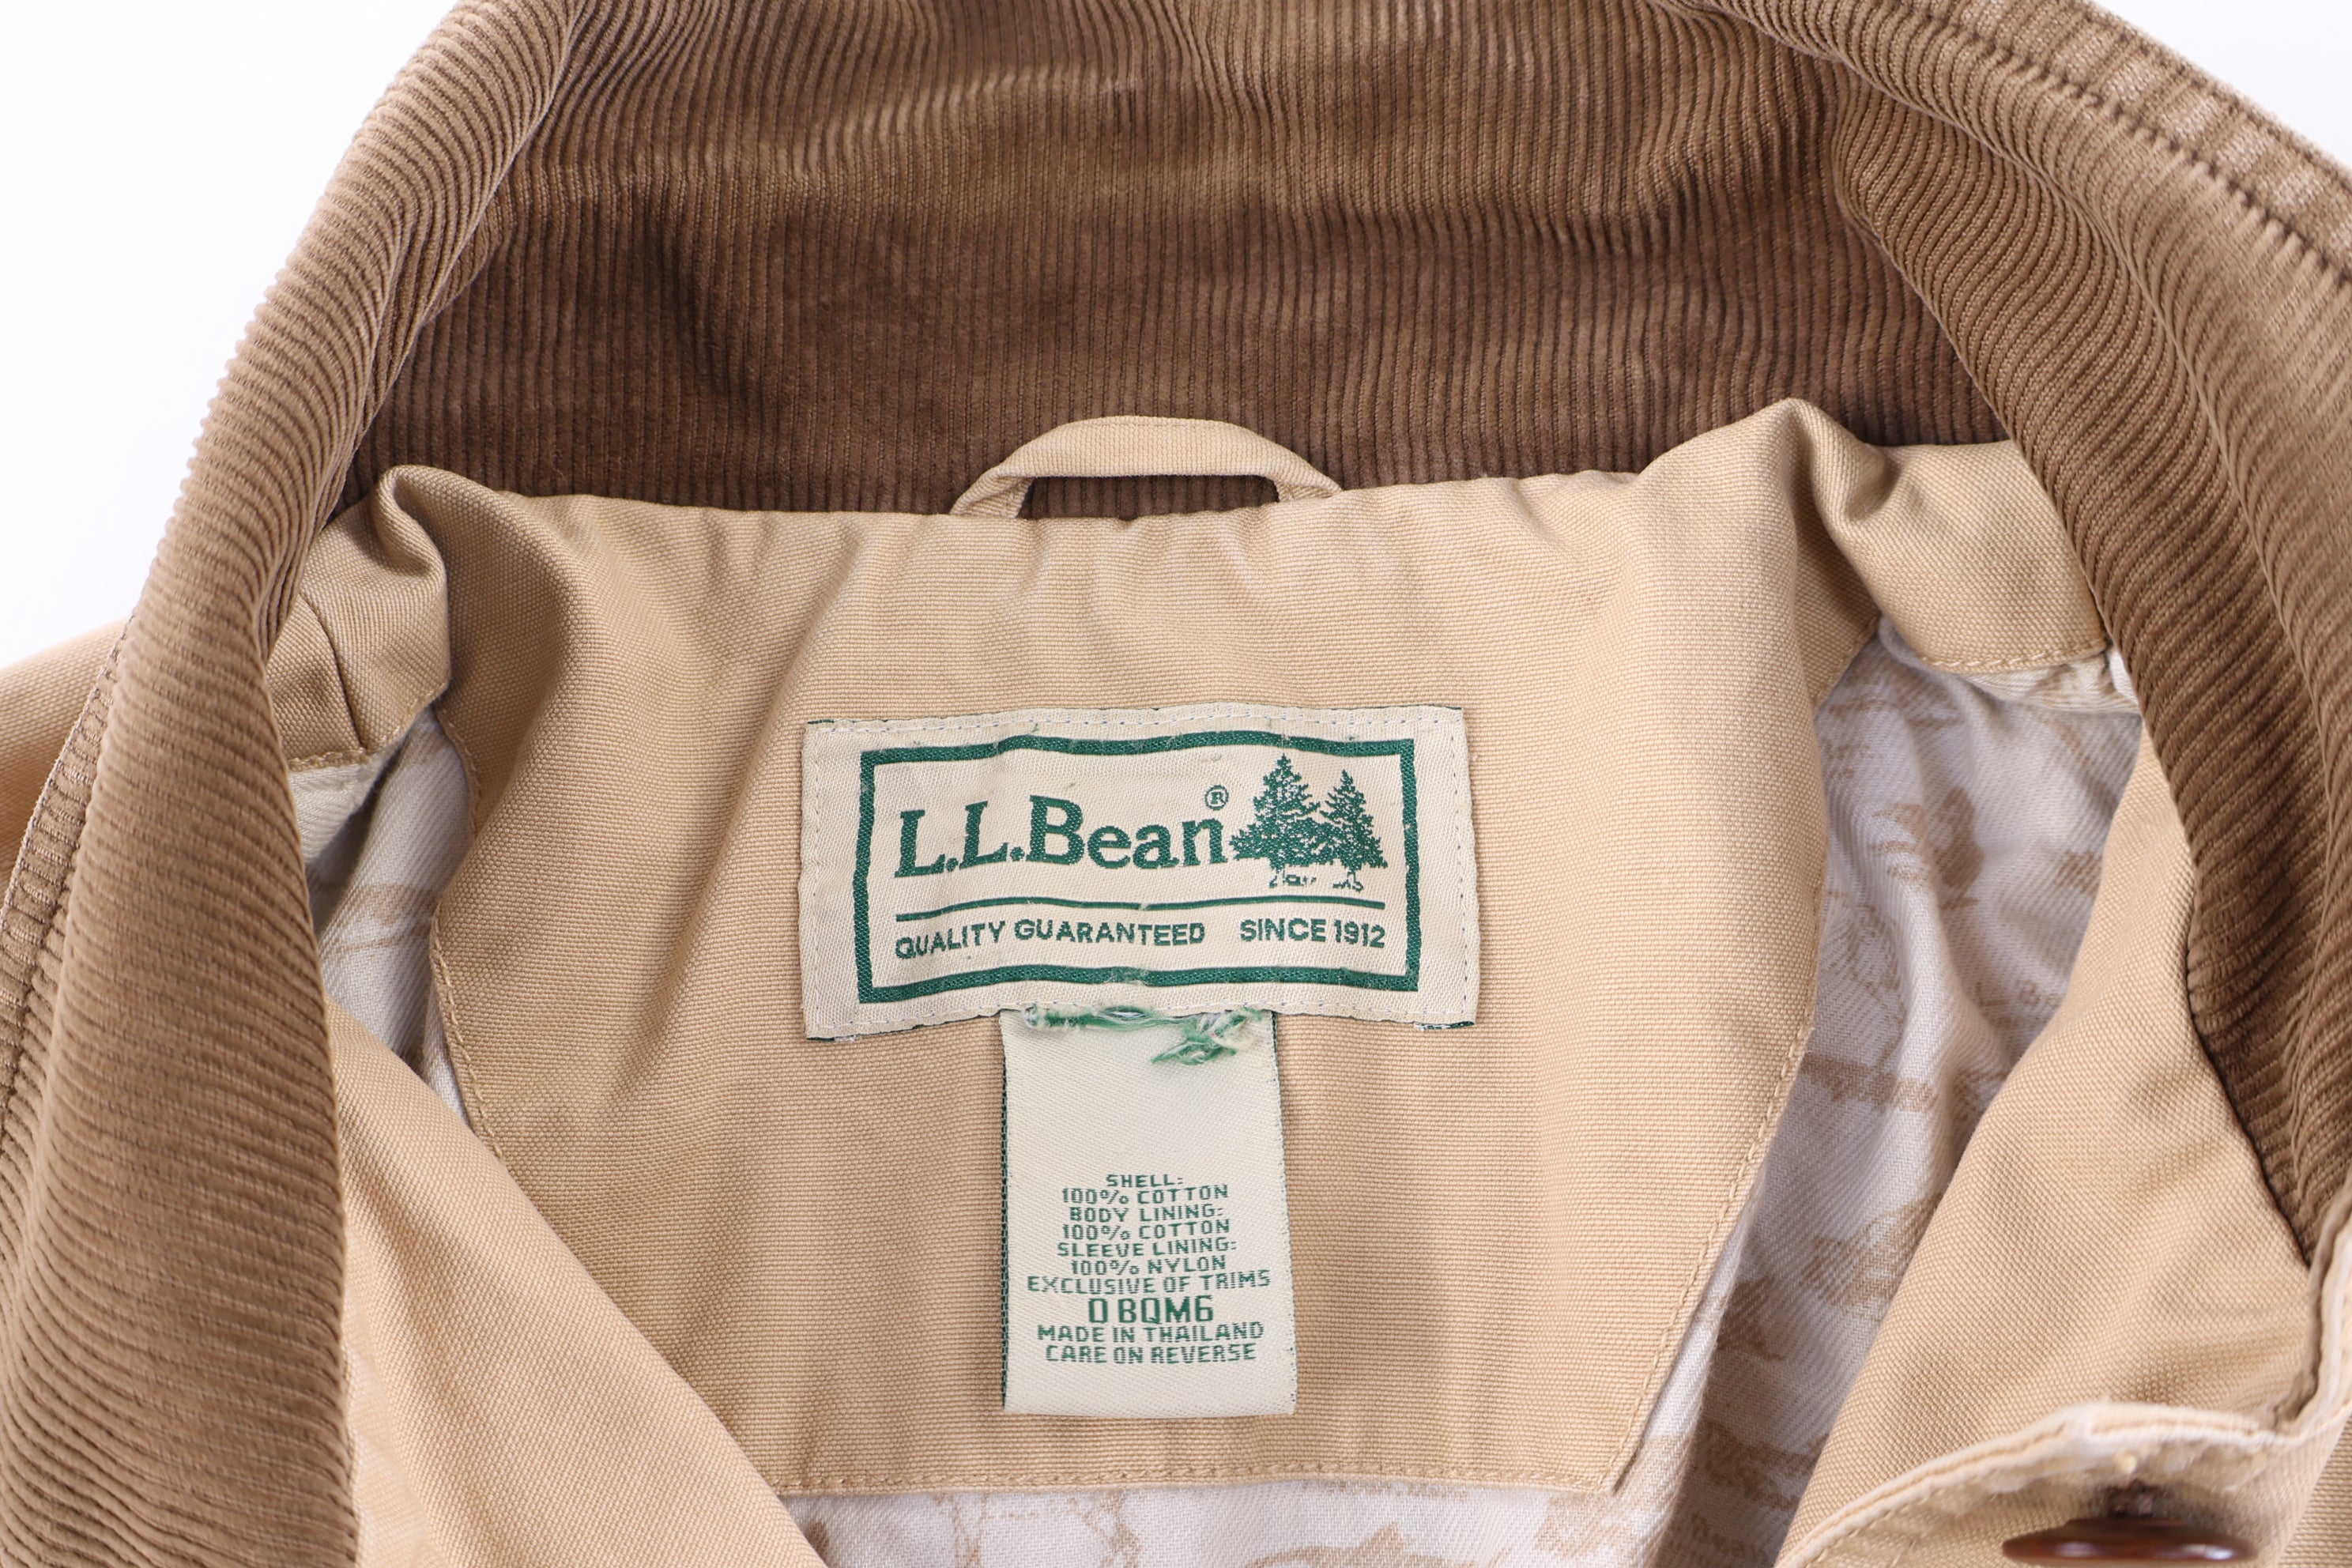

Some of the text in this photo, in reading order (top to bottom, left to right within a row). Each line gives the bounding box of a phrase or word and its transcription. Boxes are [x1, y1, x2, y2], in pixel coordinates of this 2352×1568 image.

[895, 918, 1386, 960] QUALITY GUARANTEED SINCE 1912
[1106, 1174, 1183, 1187] SHELL:
[1062, 1185, 1229, 1204] 100% COTTON
[1069, 1204, 1223, 1223] BODY LINING:
[1063, 1219, 1230, 1240] 100% COTTON
[1057, 1238, 1237, 1257] SLEEVE LINING:
[1072, 1256, 1226, 1276] 100% NYLON
[1027, 1270, 1271, 1295] EXCLUSIVE OF TRIMS
[1038, 1322, 1265, 1343] MADE IN THAILAND
[1046, 1344, 1257, 1364] CARE ON REVERSE
